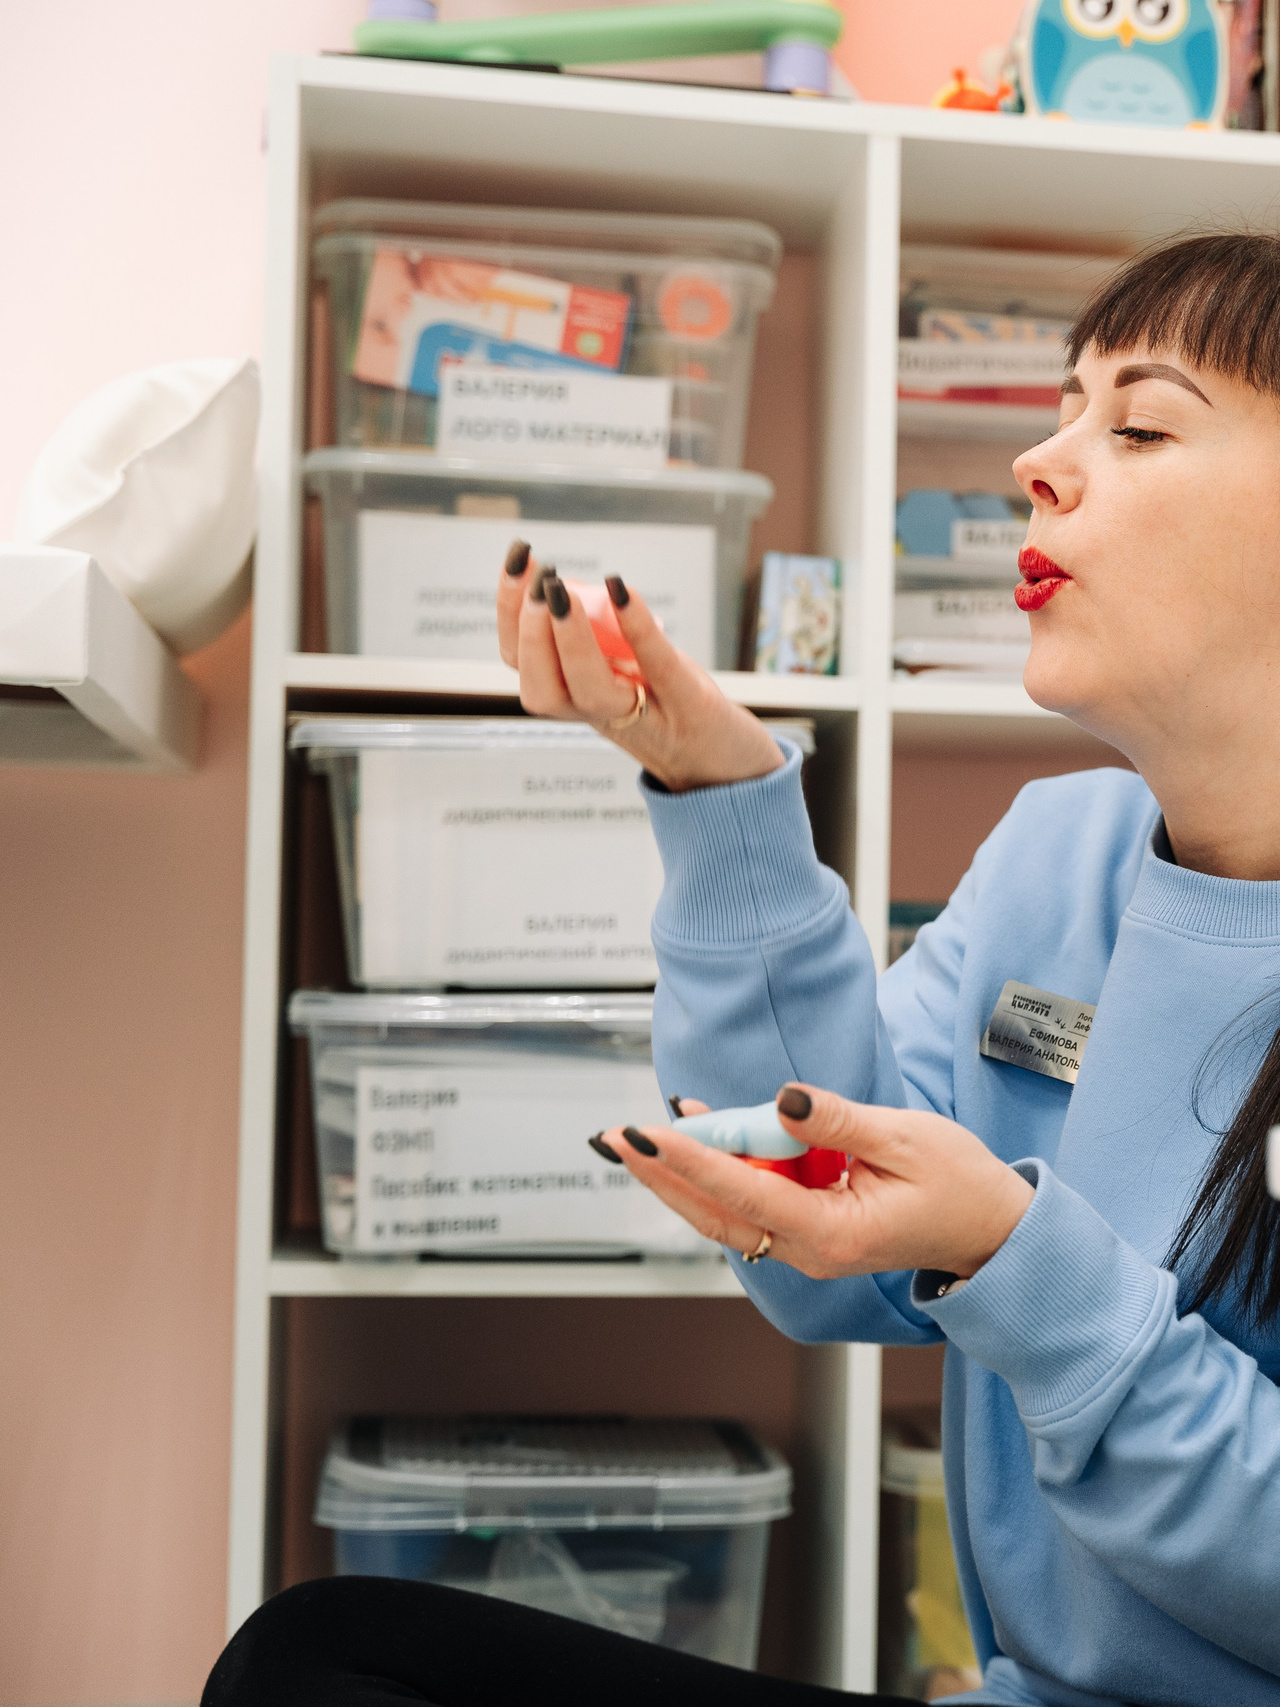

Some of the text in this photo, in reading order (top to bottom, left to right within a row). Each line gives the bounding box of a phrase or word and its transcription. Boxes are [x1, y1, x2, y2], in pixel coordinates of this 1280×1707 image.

[453, 377, 569, 403] ВАЛЕРИЯ
[450, 416, 521, 442] ЛОГО
[523, 776, 616, 794] ВАЛЕРИЯ
[525, 914, 618, 933] ВАЛЕРИЯ
[988, 1033, 1034, 1055] ВАЛЕРИЯ
[1029, 1028, 1078, 1051] ЕФИМОВА
